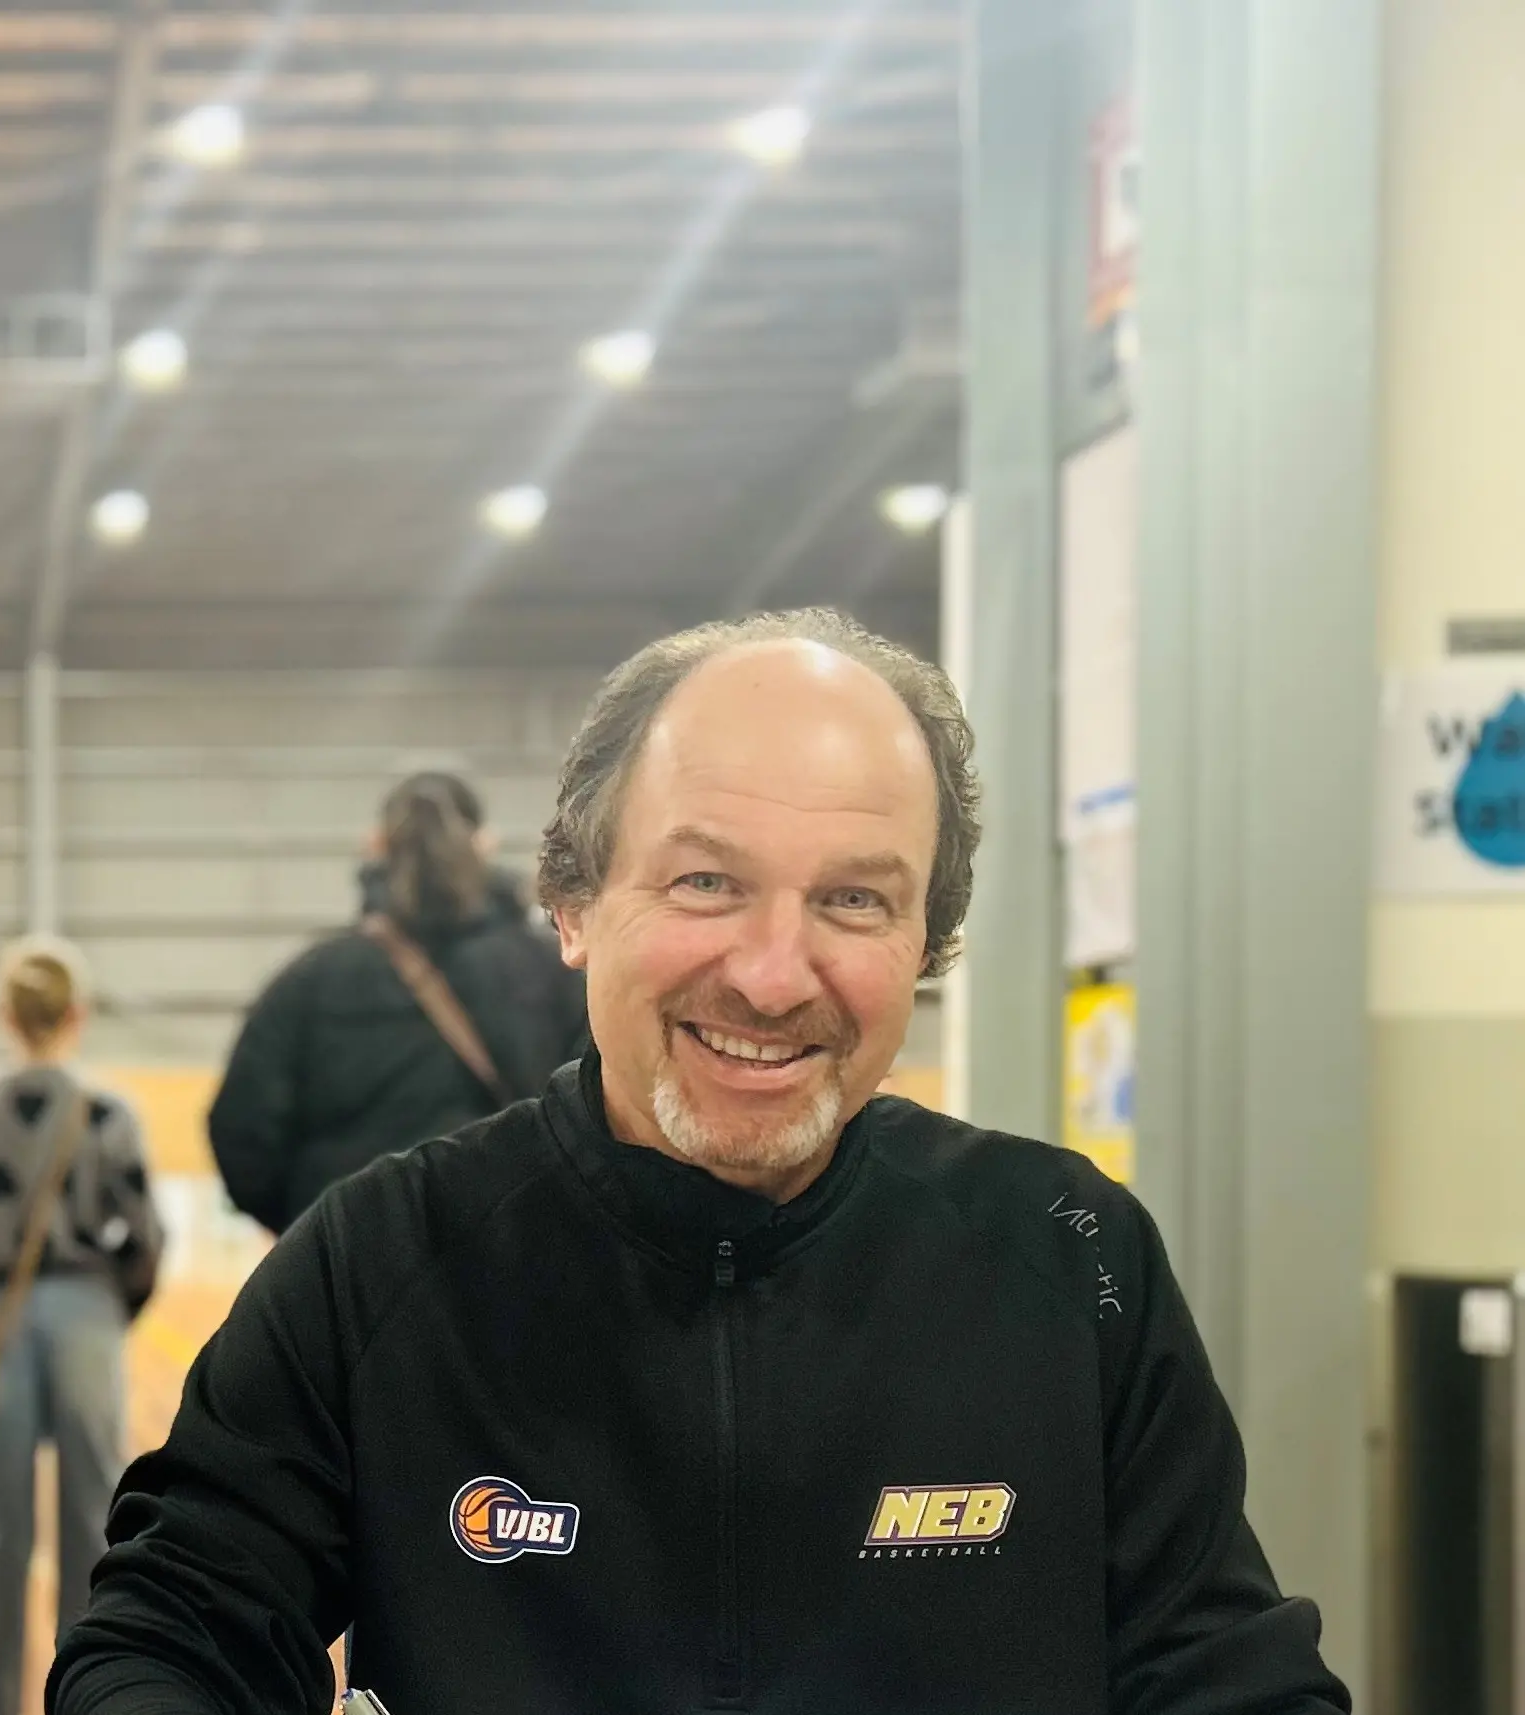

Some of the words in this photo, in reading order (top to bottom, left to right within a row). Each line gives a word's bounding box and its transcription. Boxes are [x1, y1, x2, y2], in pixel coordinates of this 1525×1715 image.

[496, 1508, 566, 1544] VJBL
[871, 1488, 1011, 1538] NEB
[858, 1546, 1002, 1559] BASKETBALL
